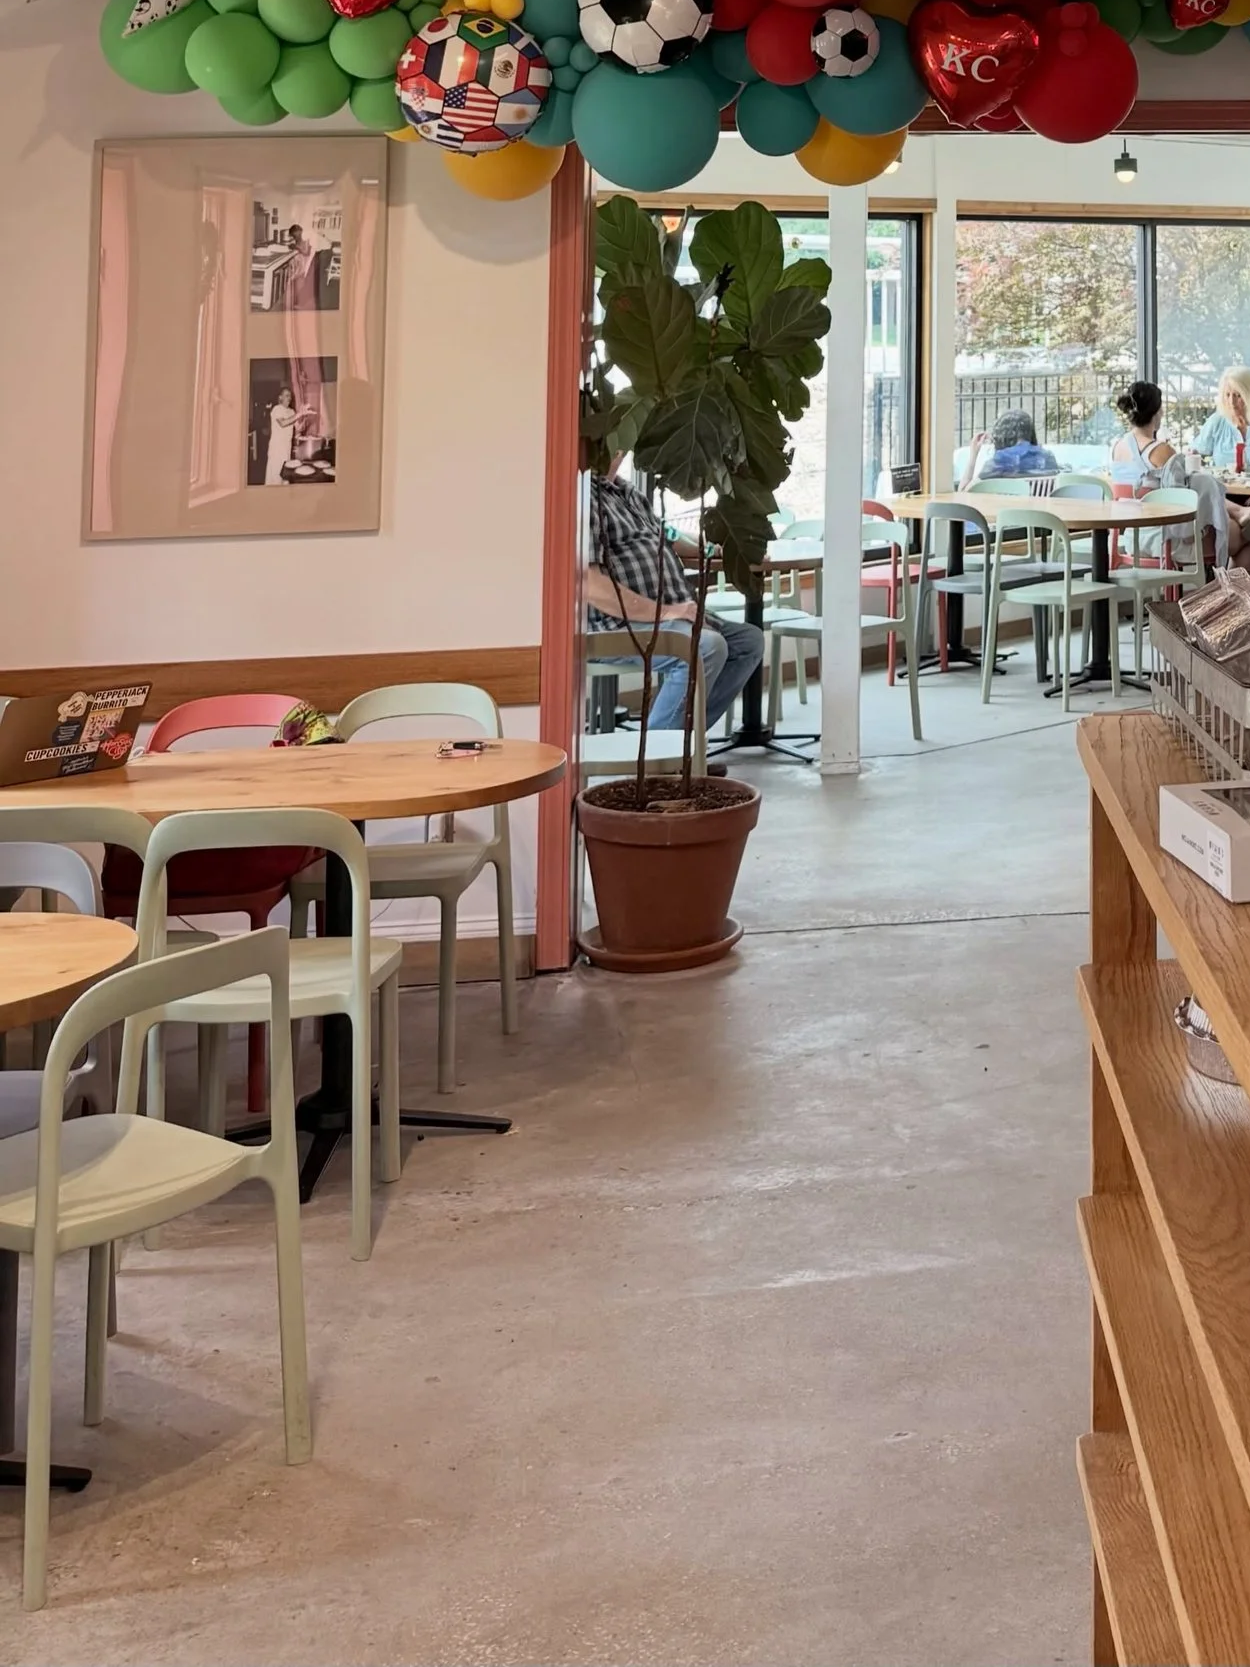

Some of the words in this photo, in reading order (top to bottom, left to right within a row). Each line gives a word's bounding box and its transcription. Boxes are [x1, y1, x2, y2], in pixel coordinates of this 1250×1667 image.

[941, 42, 999, 83] KC
[95, 687, 147, 701] PEPPERJACK
[92, 698, 128, 711] BURRITO
[26, 743, 88, 761] CUPCOOKIES
